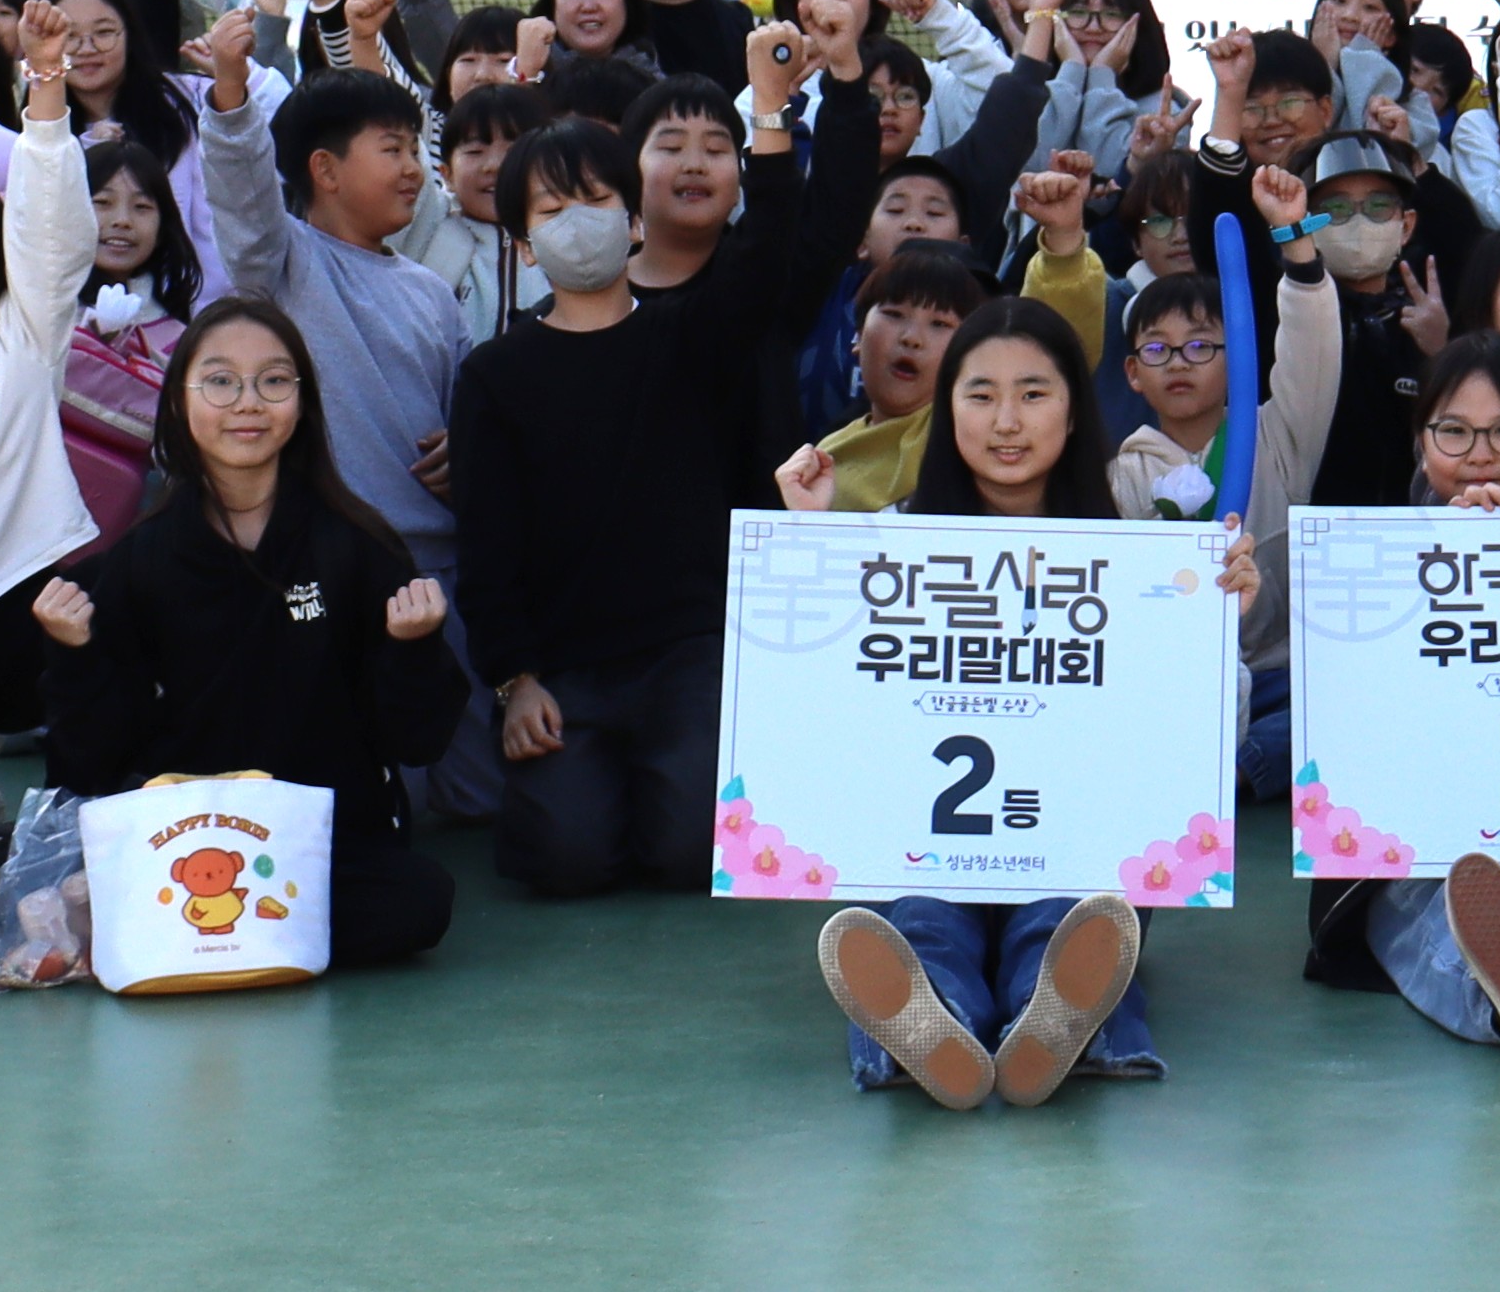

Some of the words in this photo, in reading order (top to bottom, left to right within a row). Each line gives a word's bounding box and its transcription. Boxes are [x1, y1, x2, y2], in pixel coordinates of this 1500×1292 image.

[860, 545, 1109, 636] 한글사랑
[856, 633, 1105, 687] 우리말대회
[930, 694, 998, 713] 한글골든벨
[1003, 698, 1029, 713] 수상
[931, 734, 1041, 835] 2등
[148, 812, 213, 851] HAPPY
[214, 813, 271, 841] BORIS
[946, 854, 1046, 872] 성남청소년센터
